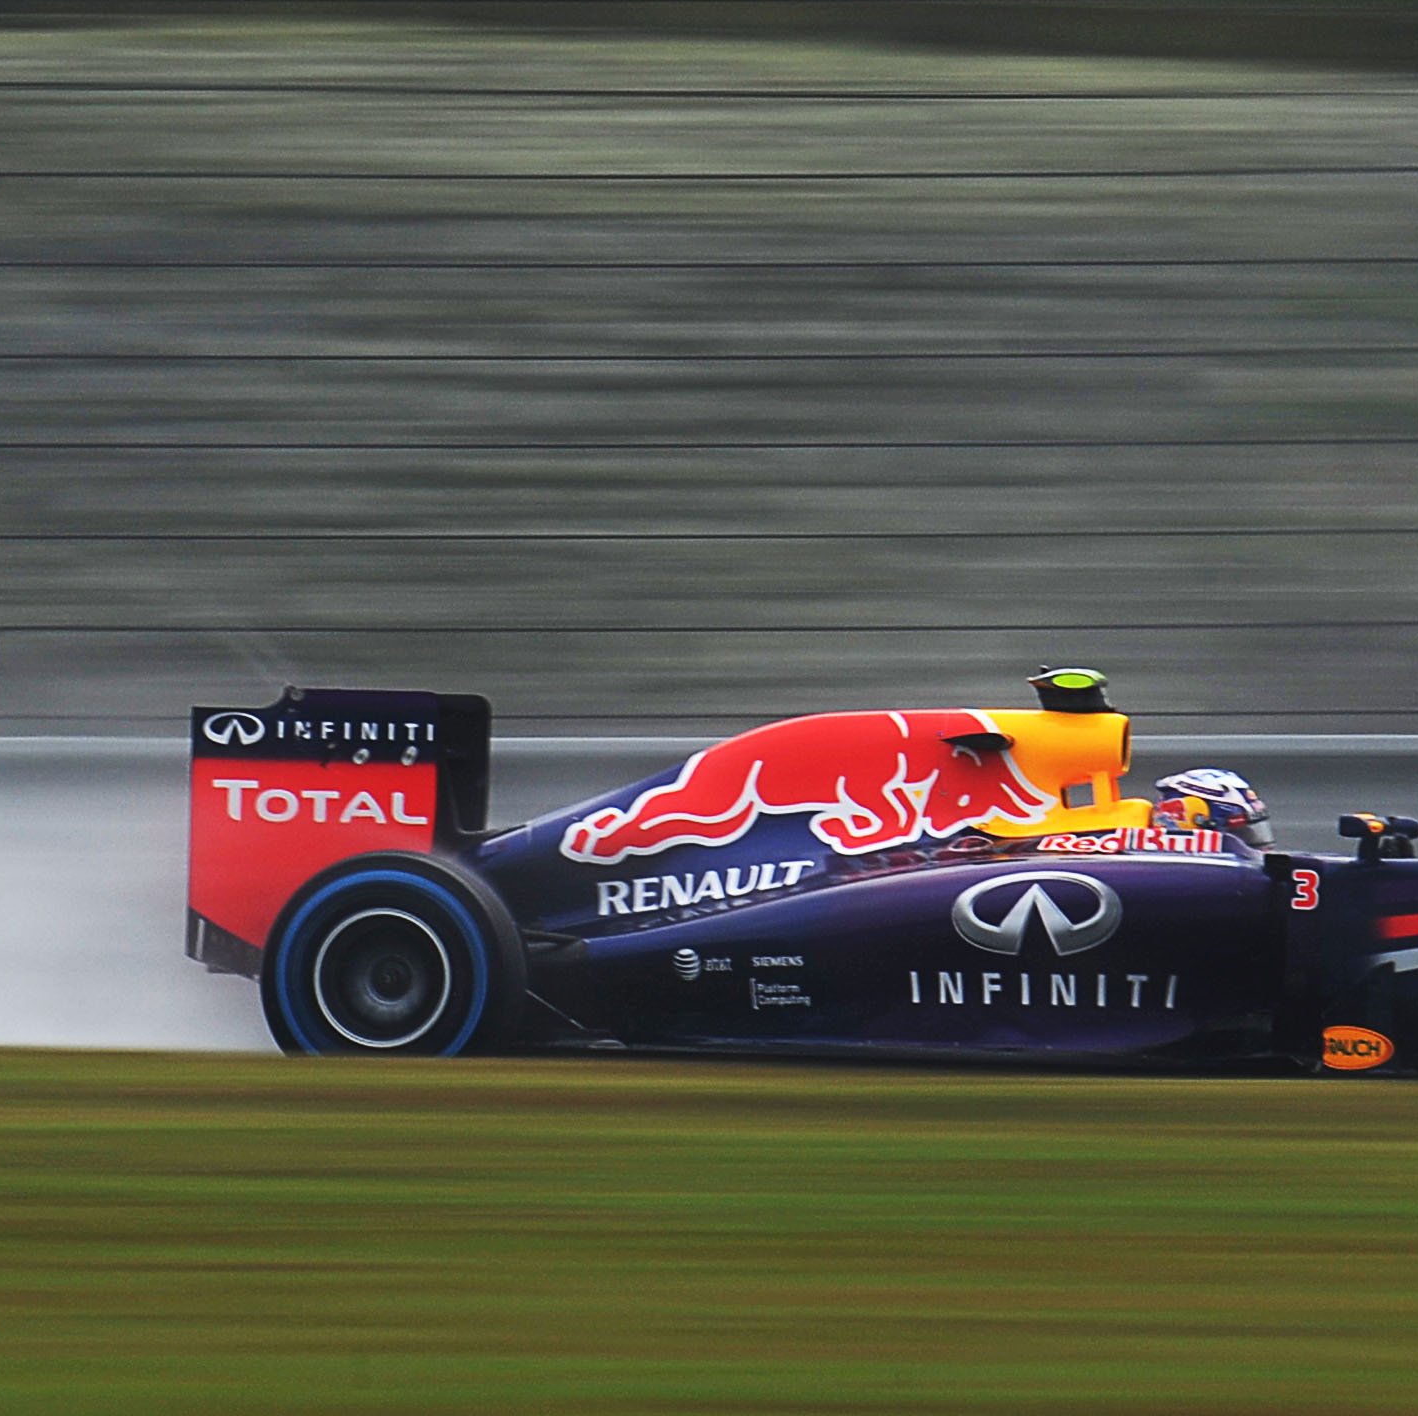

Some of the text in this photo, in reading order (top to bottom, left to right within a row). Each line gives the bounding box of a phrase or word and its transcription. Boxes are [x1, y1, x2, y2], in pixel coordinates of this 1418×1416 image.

[277, 720, 435, 742] INFINITI
[212, 778, 429, 826] TOTAL
[1037, 827, 1222, 854] Red Bull
[597, 860, 815, 916] RENAULT
[1291, 869, 1319, 910] 3
[751, 955, 804, 968] SIEMENS
[908, 970, 1178, 1009] INFINITI
